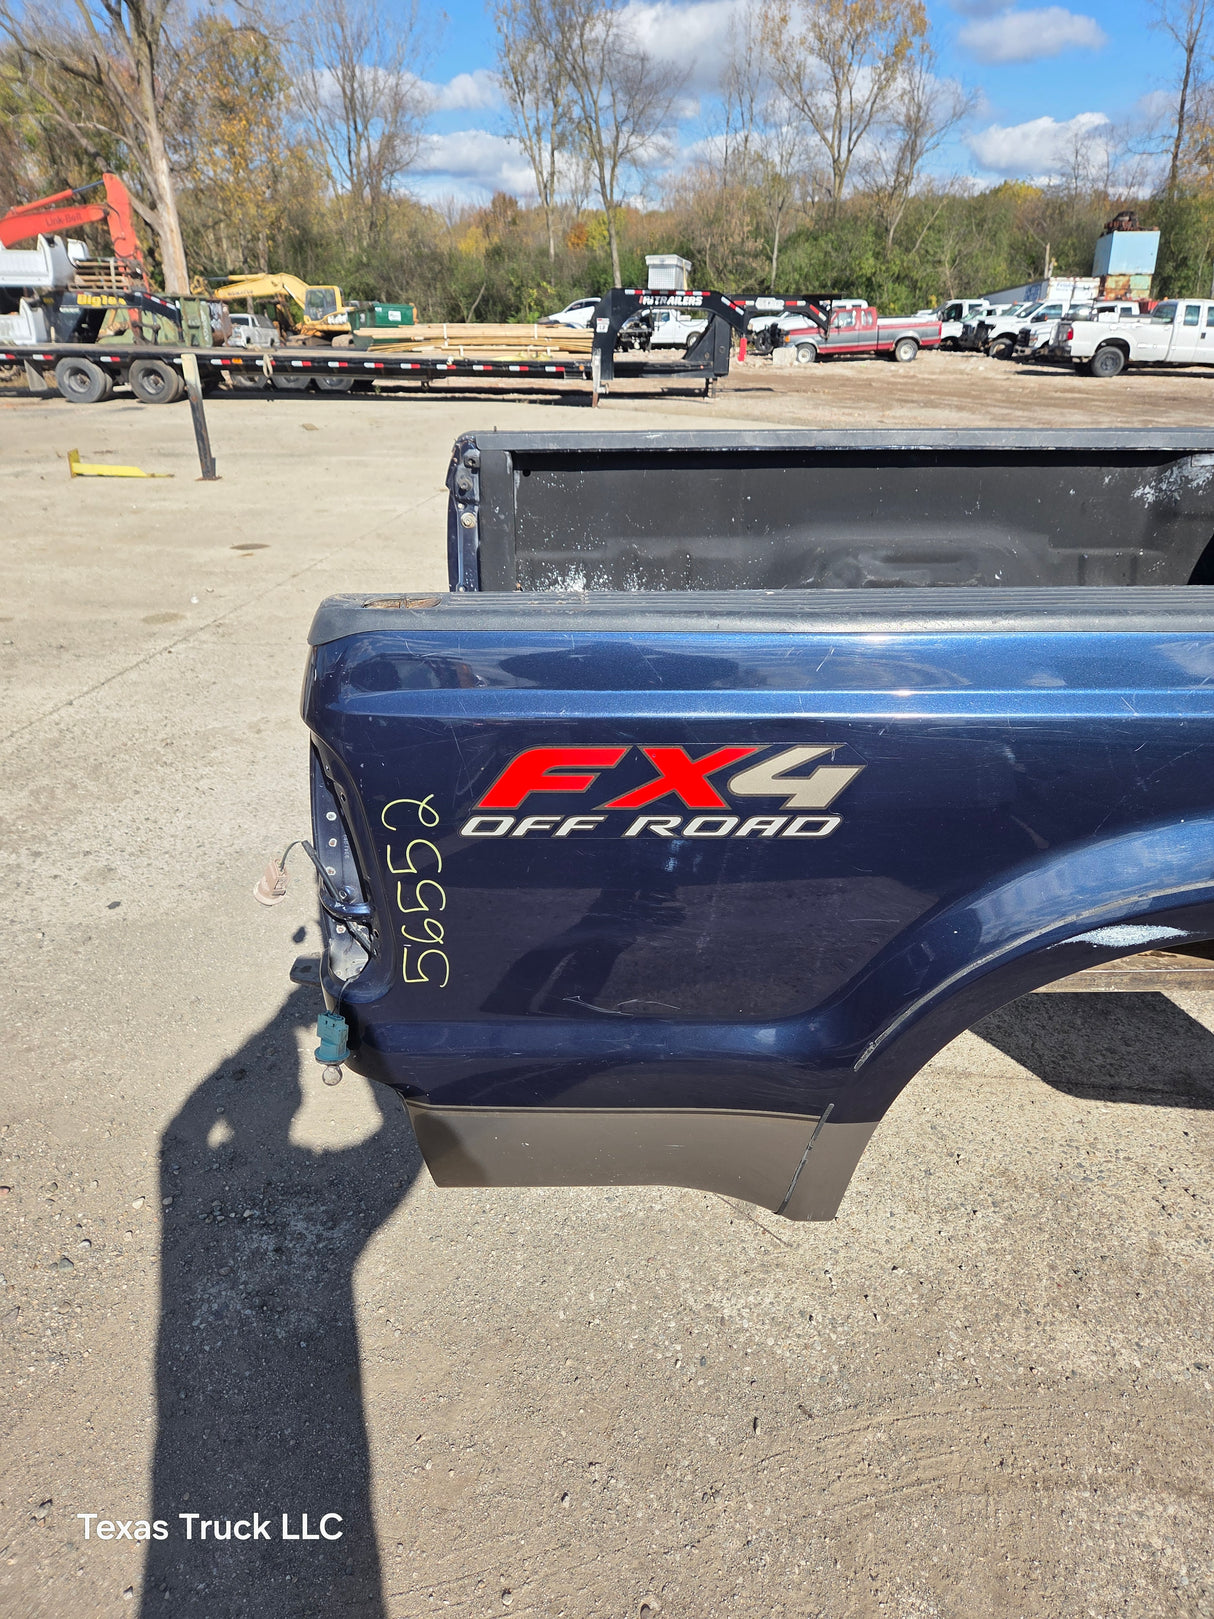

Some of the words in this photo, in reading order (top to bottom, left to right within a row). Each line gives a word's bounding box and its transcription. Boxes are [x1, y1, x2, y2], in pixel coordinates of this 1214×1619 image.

[654, 295, 703, 306] TRAILERS
[473, 745, 866, 810] FX4
[459, 815, 609, 838] OFF
[621, 815, 843, 838] ROAD
[382, 794, 449, 988] 56552
